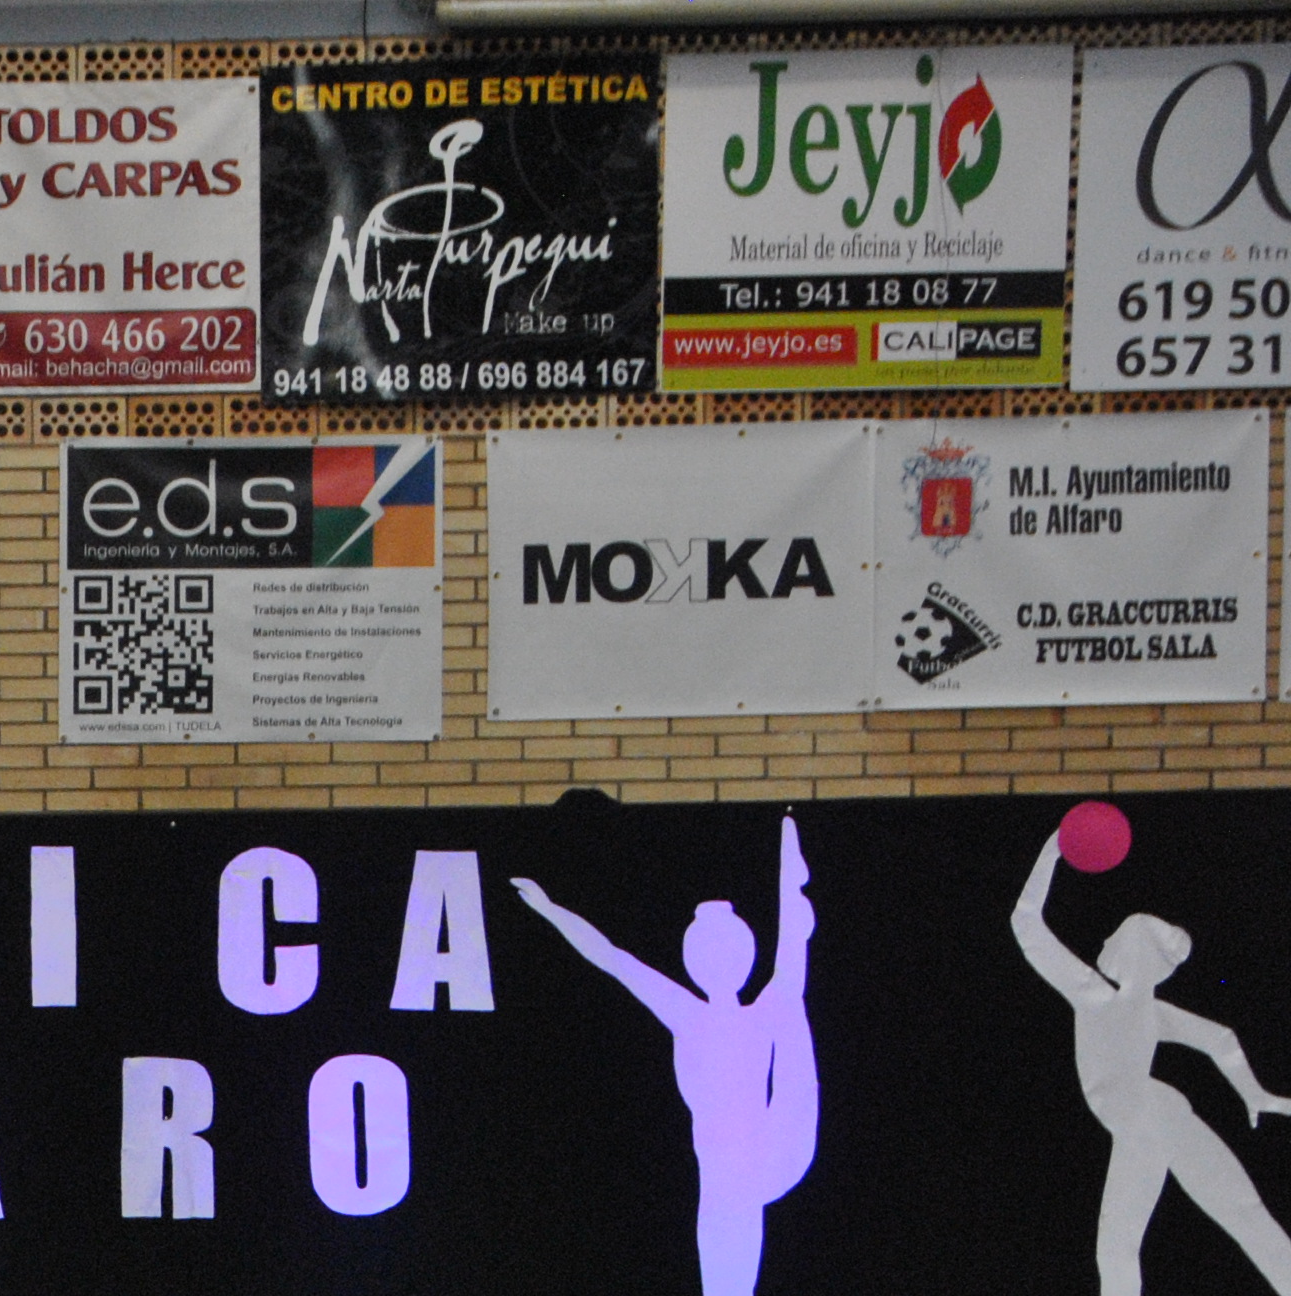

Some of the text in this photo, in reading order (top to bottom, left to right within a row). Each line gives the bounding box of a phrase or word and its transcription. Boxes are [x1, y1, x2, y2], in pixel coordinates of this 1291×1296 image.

[271, 70, 649, 113] CENTRO DE ESTÉTICA
[41, 158, 242, 199] CARPAS
[729, 230, 1004, 264] Material de oficina y Reciclaje
[1136, 245, 1211, 264] dance
[1222, 245, 1238, 262] &
[122, 250, 246, 291] Herce
[719, 277, 998, 311] Tel.: 941 18 08 77
[1118, 277, 1290, 323] 619 50
[24, 315, 243, 354] 630 466 202
[503, 312, 615, 336] Make up
[673, 329, 843, 360] www.jeyjo.es
[1117, 333, 1282, 378] 657 31
[45, 356, 252, 380] behacha@gmail.com
[273, 367, 322, 397] 941
[334, 366, 368, 394] 18
[375, 364, 410, 392] 48
[419, 363, 453, 390] 88
[477, 361, 528, 389] 696
[536, 359, 587, 388] 884
[596, 358, 647, 387] 167
[1008, 460, 1231, 501] M.I. Ayuntamiento
[1008, 502, 1123, 536] de Alfaro
[168, 545, 178, 560] y
[269, 542, 298, 557] S.A.
[252, 582, 287, 593] Redes
[289, 582, 303, 592] de
[252, 604, 299, 617] Trabajos
[301, 606, 315, 615] en
[317, 604, 339, 615] Alta
[341, 607, 348, 617] y
[350, 603, 375, 616] Baja
[1016, 596, 1239, 628] C.D. GRACCURRIS
[252, 625, 422, 638] Mantenimiento de Instalaciones
[252, 649, 302, 660] Servicios
[1035, 632, 1218, 664] FUTBOL SALA
[302, 671, 366, 682] Renovables
[252, 694, 307, 707] Proyectos
[309, 694, 323, 705] de
[175, 721, 222, 731] TUDELA
[252, 716, 302, 727] Sistemas
[304, 716, 318, 727] de
[320, 715, 342, 727] Alta
